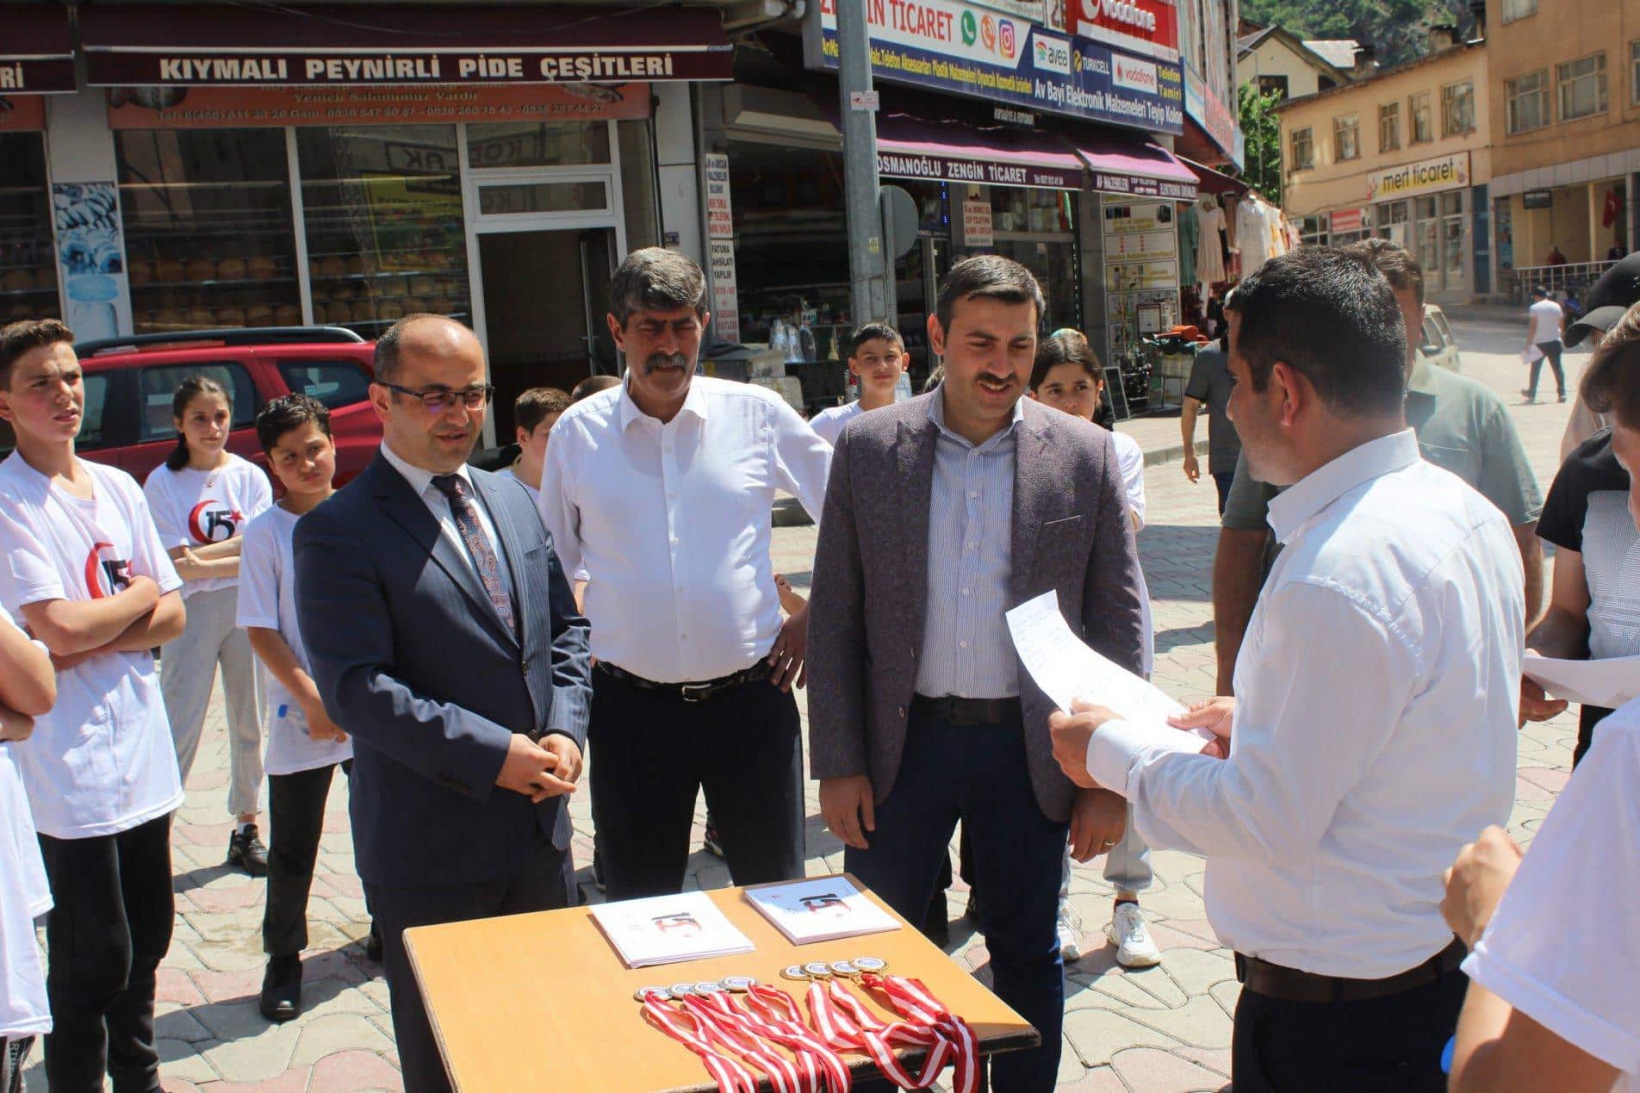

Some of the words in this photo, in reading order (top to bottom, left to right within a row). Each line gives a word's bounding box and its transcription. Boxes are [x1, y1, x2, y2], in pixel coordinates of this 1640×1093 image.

[160, 58, 287, 80] KIYMALI
[305, 55, 440, 80] PEYNİRLİ
[459, 53, 524, 78] PİDE
[540, 52, 674, 82] ÇEŞİTLERİ
[1048, 47, 1068, 67] avea
[1125, 68, 1155, 86] vodafone
[1158, 65, 1181, 82] Telefon
[1035, 78, 1046, 100] Av
[1047, 80, 1064, 107] Bayi
[1066, 84, 1105, 110] Elektronik
[1105, 93, 1146, 119] Malzemeleri
[1146, 102, 1165, 125] Teyip
[1165, 104, 1184, 125] Kolon
[877, 155, 941, 176] OSMANOĞLU
[947, 160, 984, 180] ZENGİN
[988, 163, 1027, 183] TİCARET
[1383, 166, 1410, 193] mert
[1412, 157, 1454, 185] ticaret
[711, 244, 730, 254] FATURA
[205, 509, 236, 542] 15
